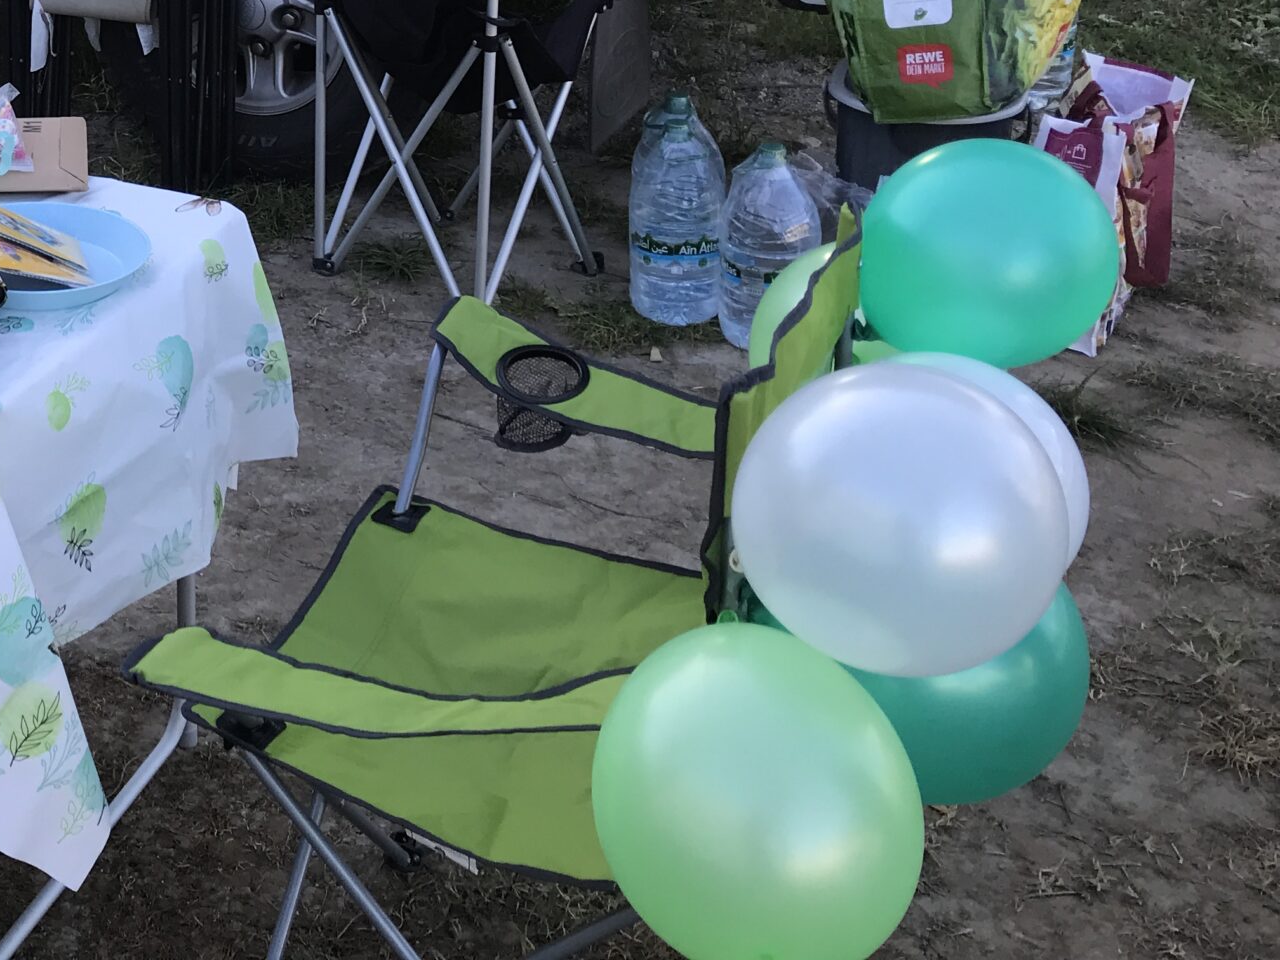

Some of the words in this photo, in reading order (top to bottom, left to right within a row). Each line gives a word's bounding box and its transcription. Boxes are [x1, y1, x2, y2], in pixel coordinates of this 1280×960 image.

[906, 51, 945, 65] REWE
[907, 65, 922, 76] DEIN
[923, 63, 945, 75] MARKT
[679, 244, 698, 256] Aïn
